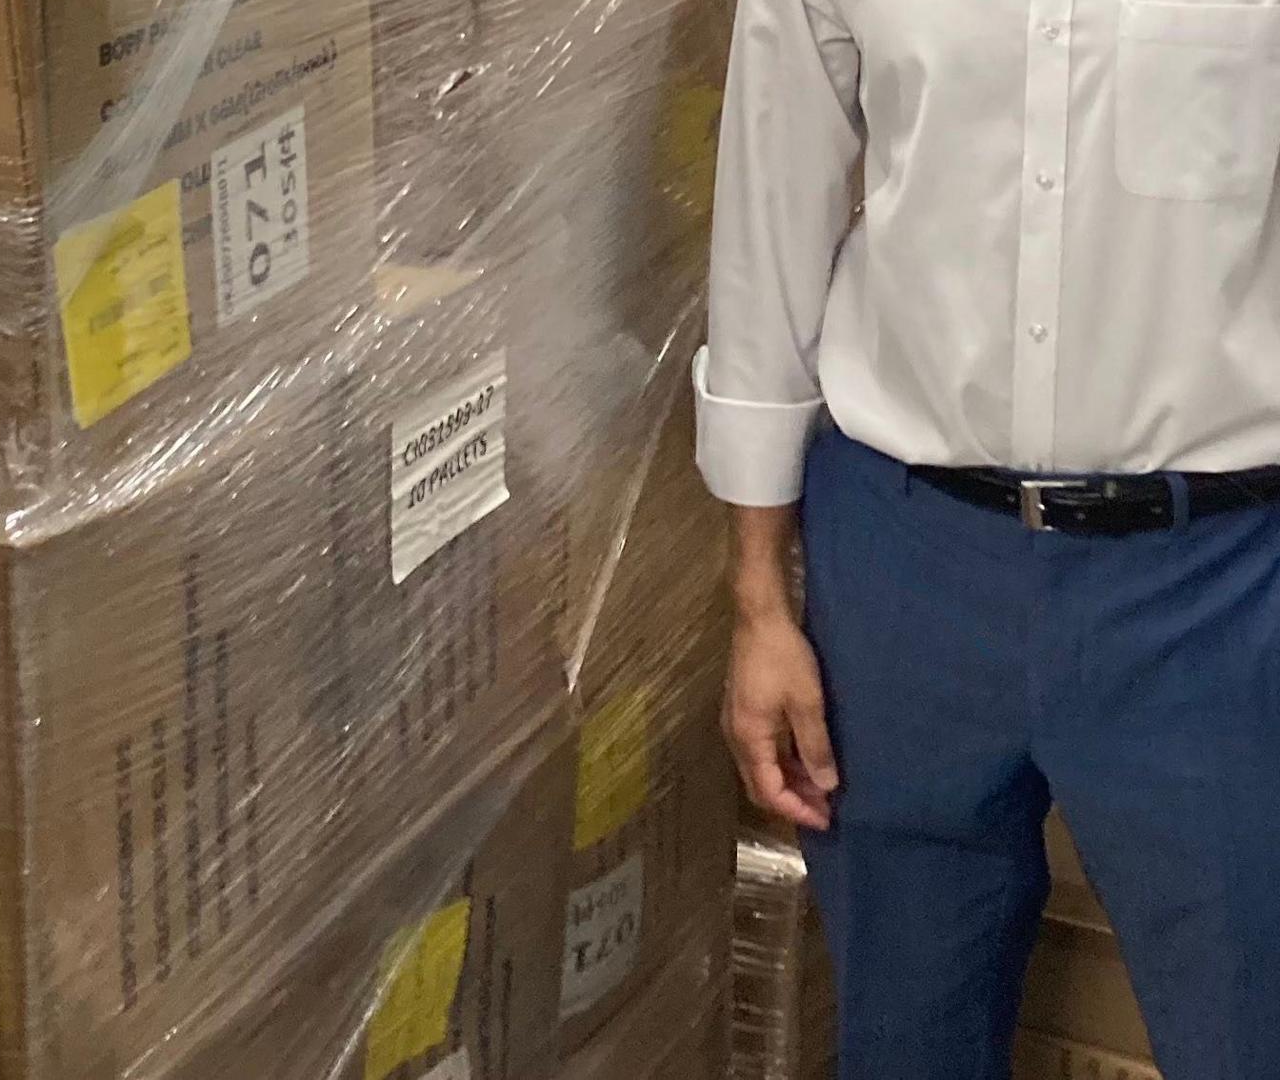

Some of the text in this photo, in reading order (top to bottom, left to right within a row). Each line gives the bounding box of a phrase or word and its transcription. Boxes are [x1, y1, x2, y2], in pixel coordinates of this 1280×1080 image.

[243, 141, 272, 287] 071
[407, 431, 488, 510] 10 PALLETS
